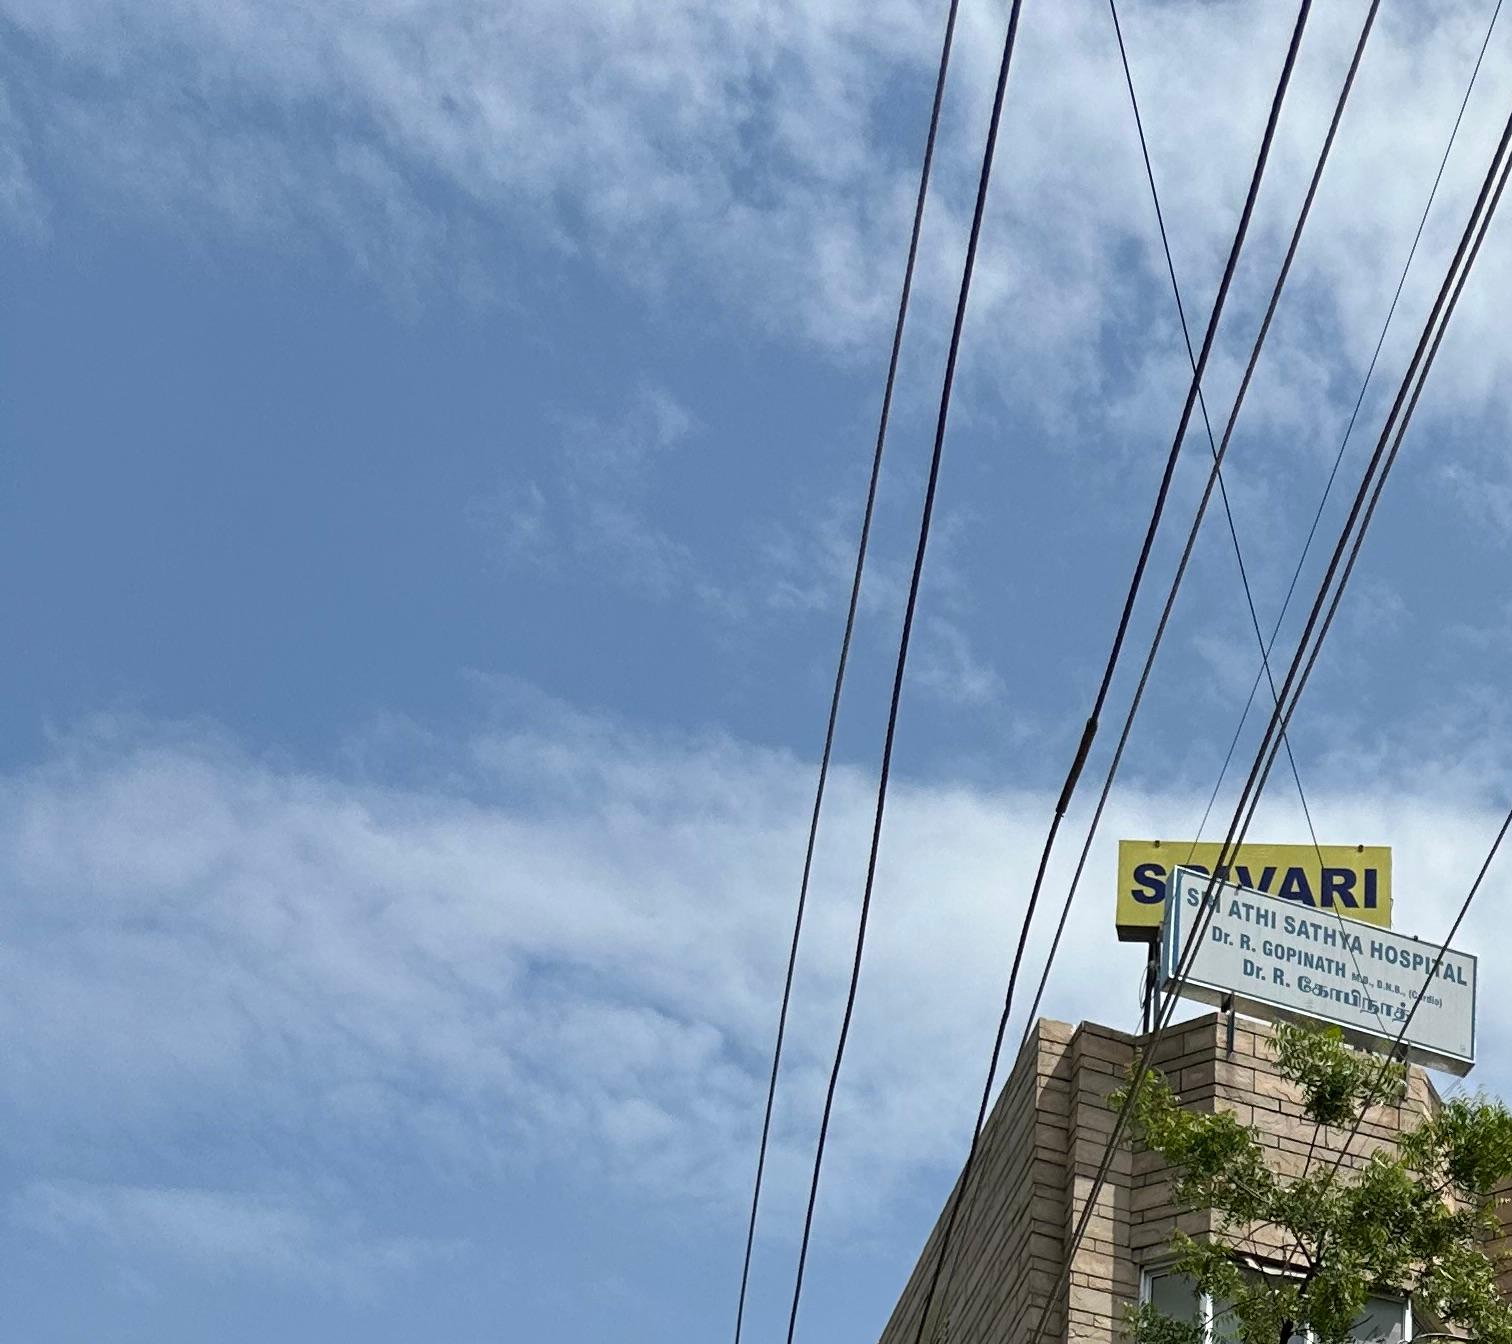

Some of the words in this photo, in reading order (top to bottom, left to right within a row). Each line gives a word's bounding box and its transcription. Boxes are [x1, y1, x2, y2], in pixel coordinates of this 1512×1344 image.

[1212, 926, 1233, 945] Dr.
[1240, 934, 1256, 952] R.
[1263, 940, 1346, 978] GOPINATH
[1229, 900, 1276, 929] ATHI
[1284, 915, 1363, 955] SATHYA
[1370, 940, 1467, 986] HOSPITAL
[1243, 958, 1266, 981] Dr.
[1273, 967, 1290, 987] R.
